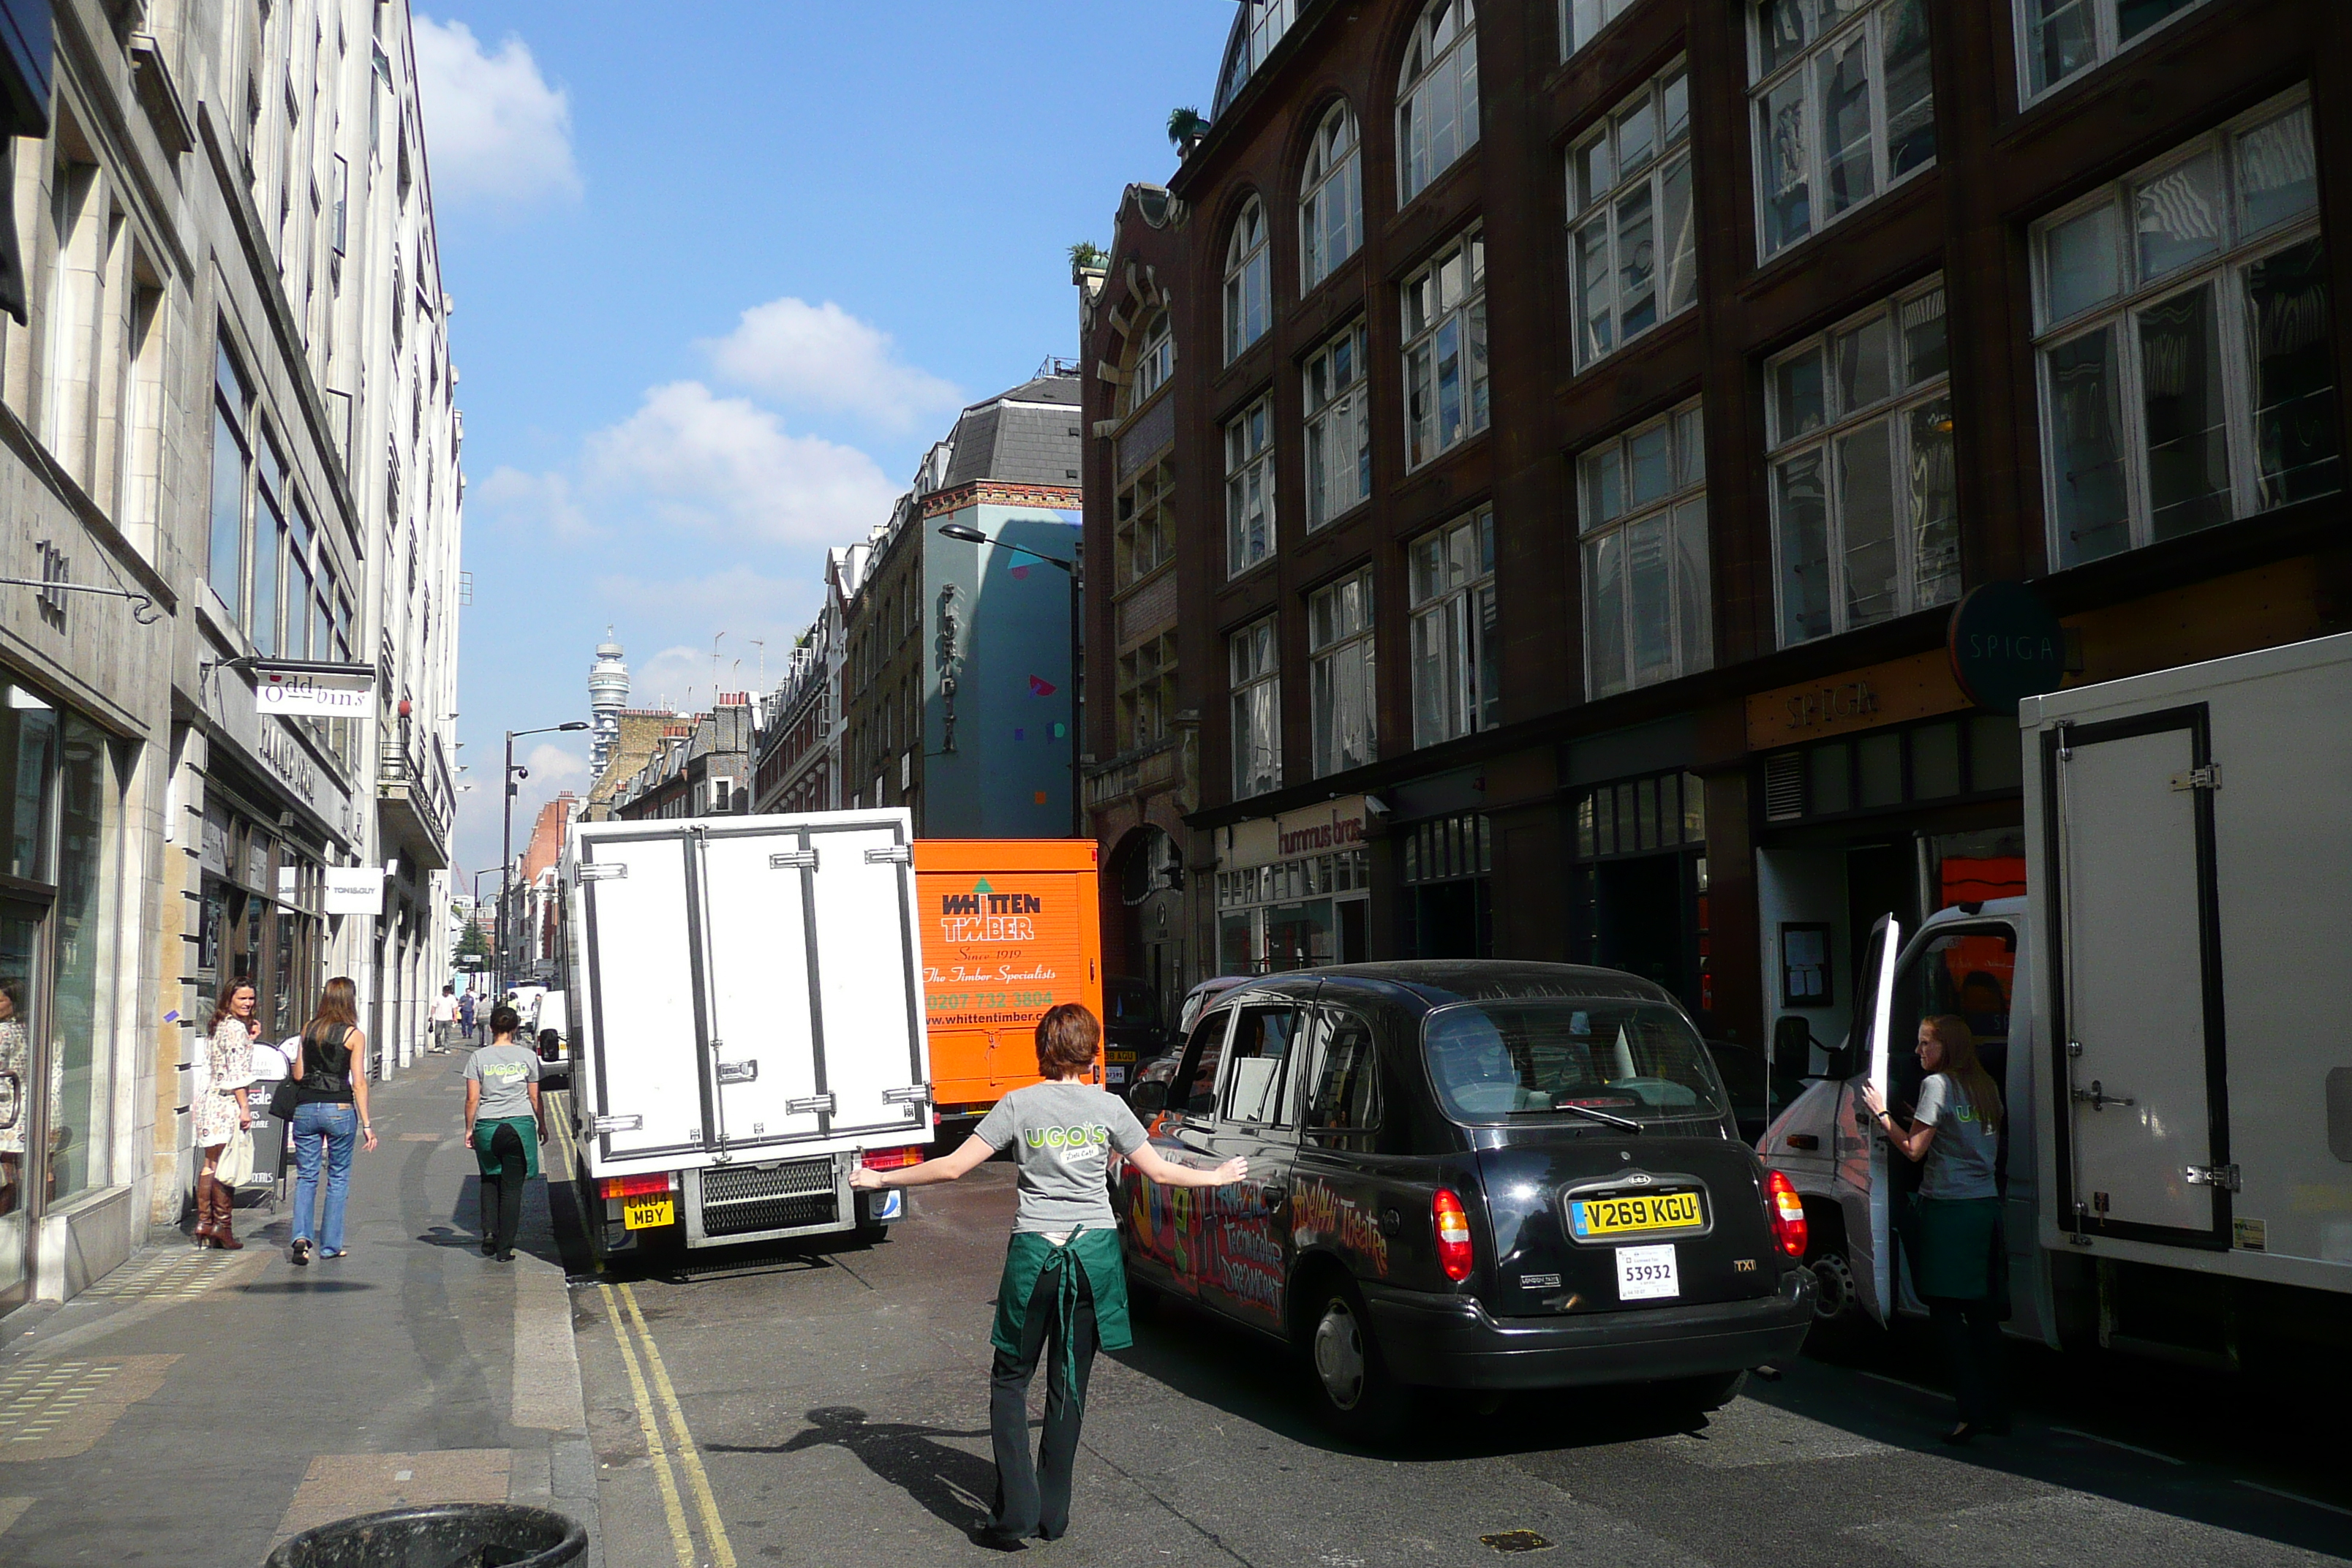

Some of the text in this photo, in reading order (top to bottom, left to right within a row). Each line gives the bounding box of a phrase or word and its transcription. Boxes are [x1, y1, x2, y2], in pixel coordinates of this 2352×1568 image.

[1970, 633, 2054, 661] SPIGA
[265, 676, 365, 706] Oddbins
[1784, 680, 1878, 729] SPIGA
[1278, 808, 1363, 855] hummus bros
[333, 886, 376, 894] TONI&GUY
[942, 892, 1041, 915] WHITTEN
[941, 916, 1034, 942] TIMBER
[954, 946, 1022, 961] Since 1919
[923, 963, 1056, 984] The Timber Specialists
[927, 990, 1053, 1010] 0207 732 3804
[1025, 1120, 1107, 1148] UGO'S
[627, 1192, 669, 1209] CN04
[634, 1208, 664, 1225] MBY
[1587, 1197, 1695, 1228] V269 KGU
[1626, 1264, 1671, 1282] 53932
